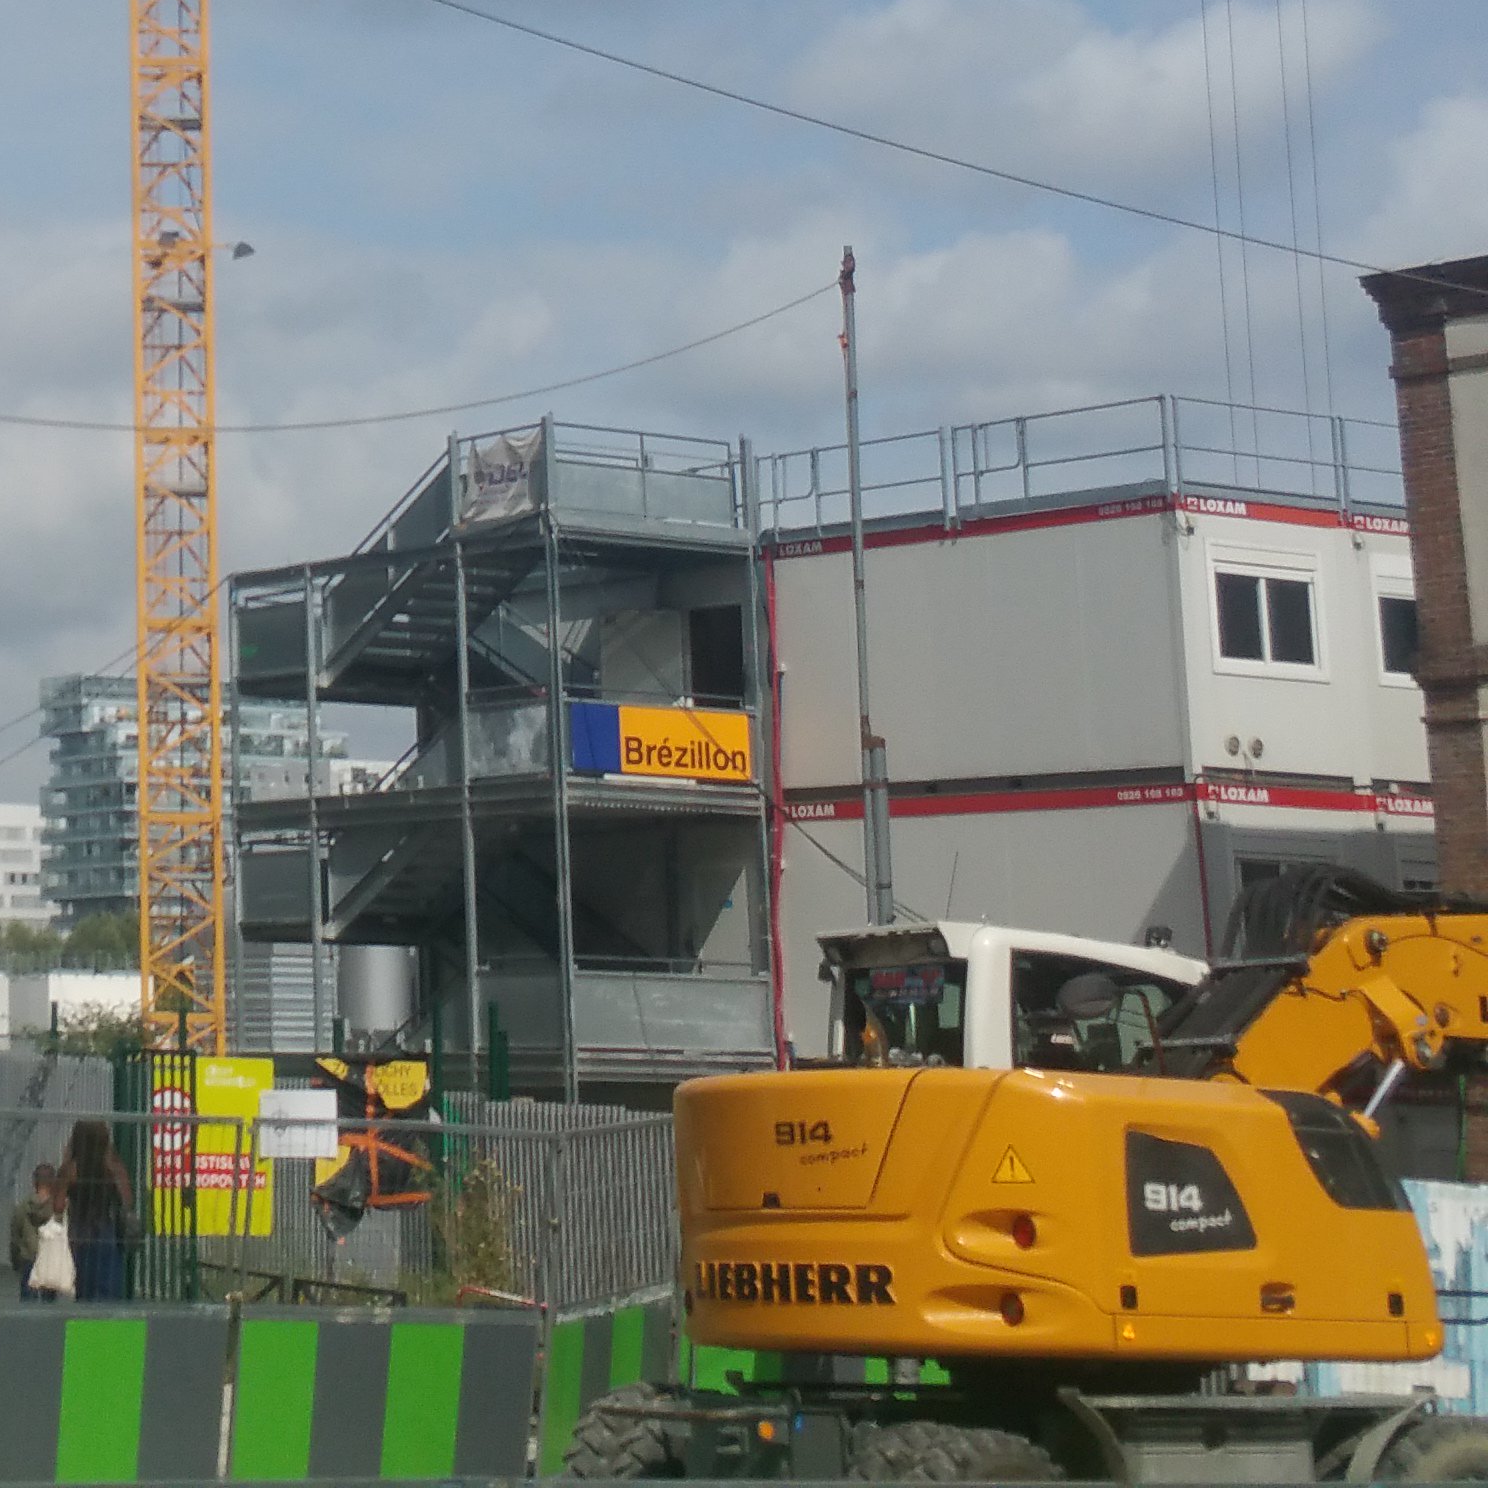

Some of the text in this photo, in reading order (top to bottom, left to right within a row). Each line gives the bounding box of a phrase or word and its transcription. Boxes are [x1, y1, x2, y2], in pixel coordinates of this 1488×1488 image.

[1199, 498, 1246, 515] LOXAM
[624, 736, 747, 772] Brézillon
[1221, 787, 1269, 803] LOXAM
[1387, 799, 1433, 812] LOXAM
[791, 803, 835, 818] LOXAM
[775, 1120, 832, 1146] 914
[799, 1141, 869, 1166] compact
[1144, 1182, 1203, 1211] 914
[1170, 1208, 1232, 1232] compact
[695, 1263, 895, 1305] LIEBHERR
